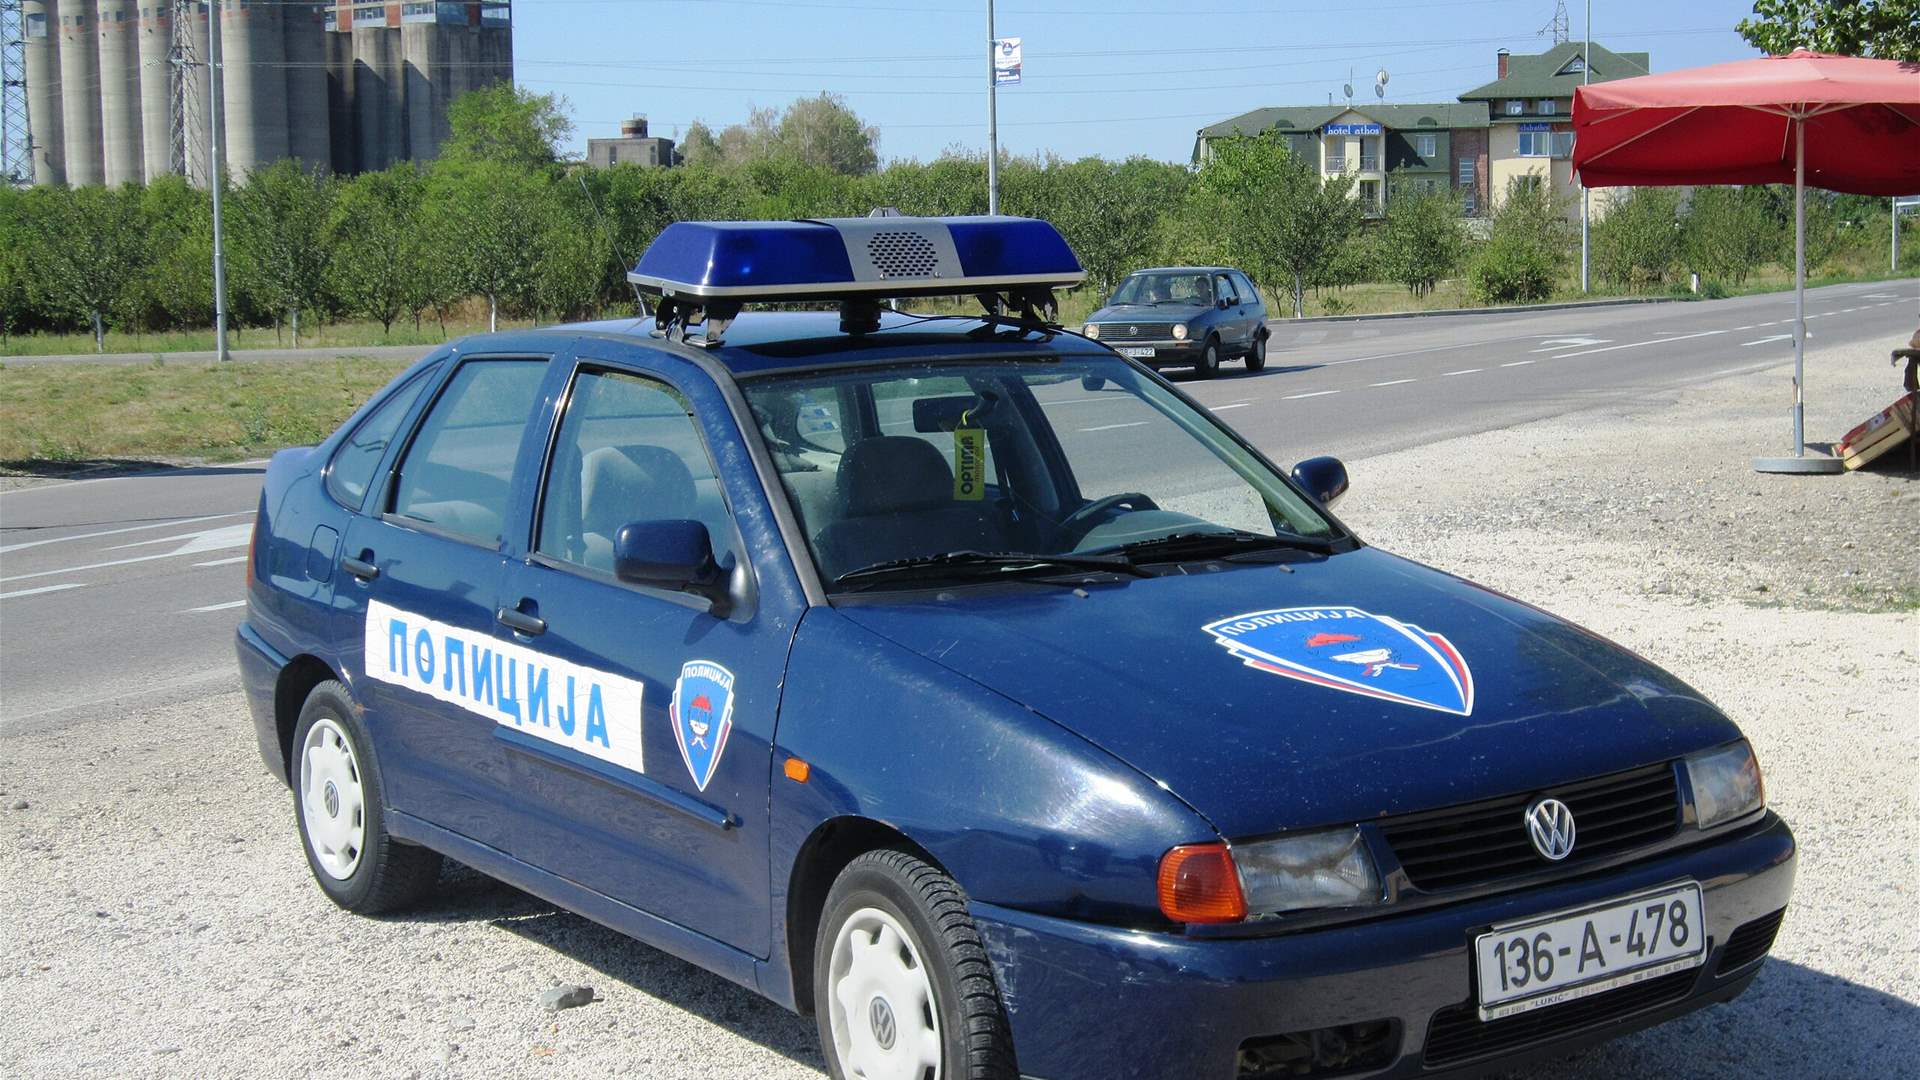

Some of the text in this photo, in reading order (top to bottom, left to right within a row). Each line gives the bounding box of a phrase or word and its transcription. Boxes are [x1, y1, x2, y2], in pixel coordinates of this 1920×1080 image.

[1328, 124, 1380, 134] hotel athos
[960, 436, 974, 495] OPTIMA
[1218, 610, 1367, 636] ПОЛИЦИЈА
[388, 618, 611, 749] ПОЛИЦИЈА
[684, 665, 731, 691] ПОЛИЦИЈА
[1494, 899, 1689, 991] 136-A-478
